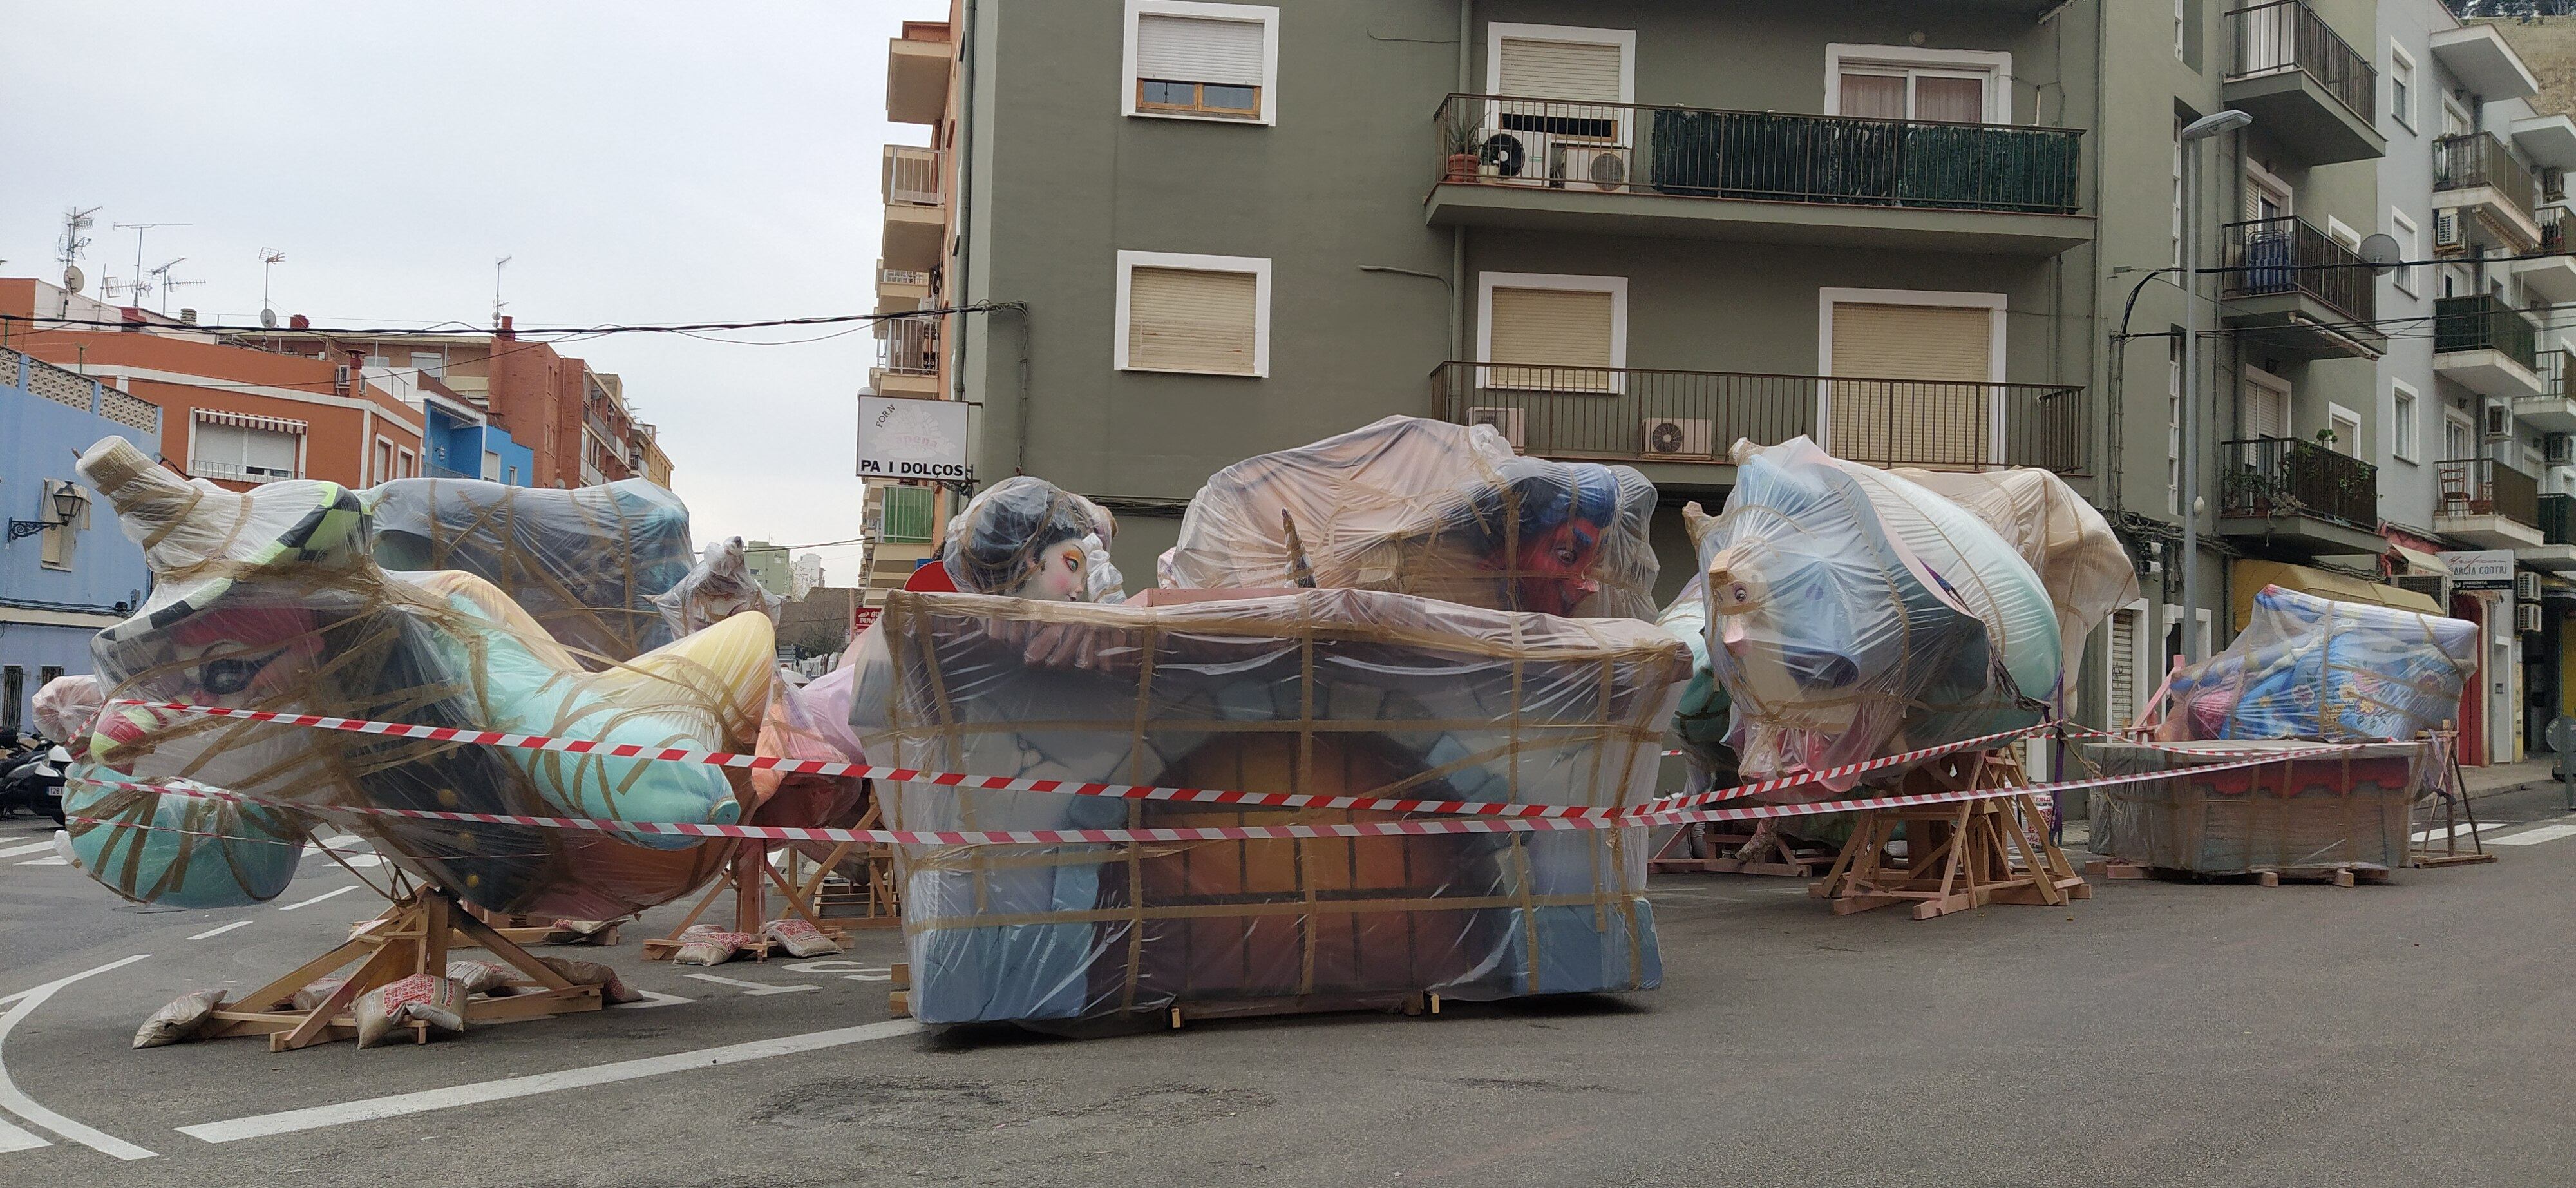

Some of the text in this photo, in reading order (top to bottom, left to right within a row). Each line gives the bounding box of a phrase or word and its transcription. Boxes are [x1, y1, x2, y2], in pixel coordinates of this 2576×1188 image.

[876, 403, 896, 428] FORN
[860, 459, 963, 478] PA I DOLÇOS
